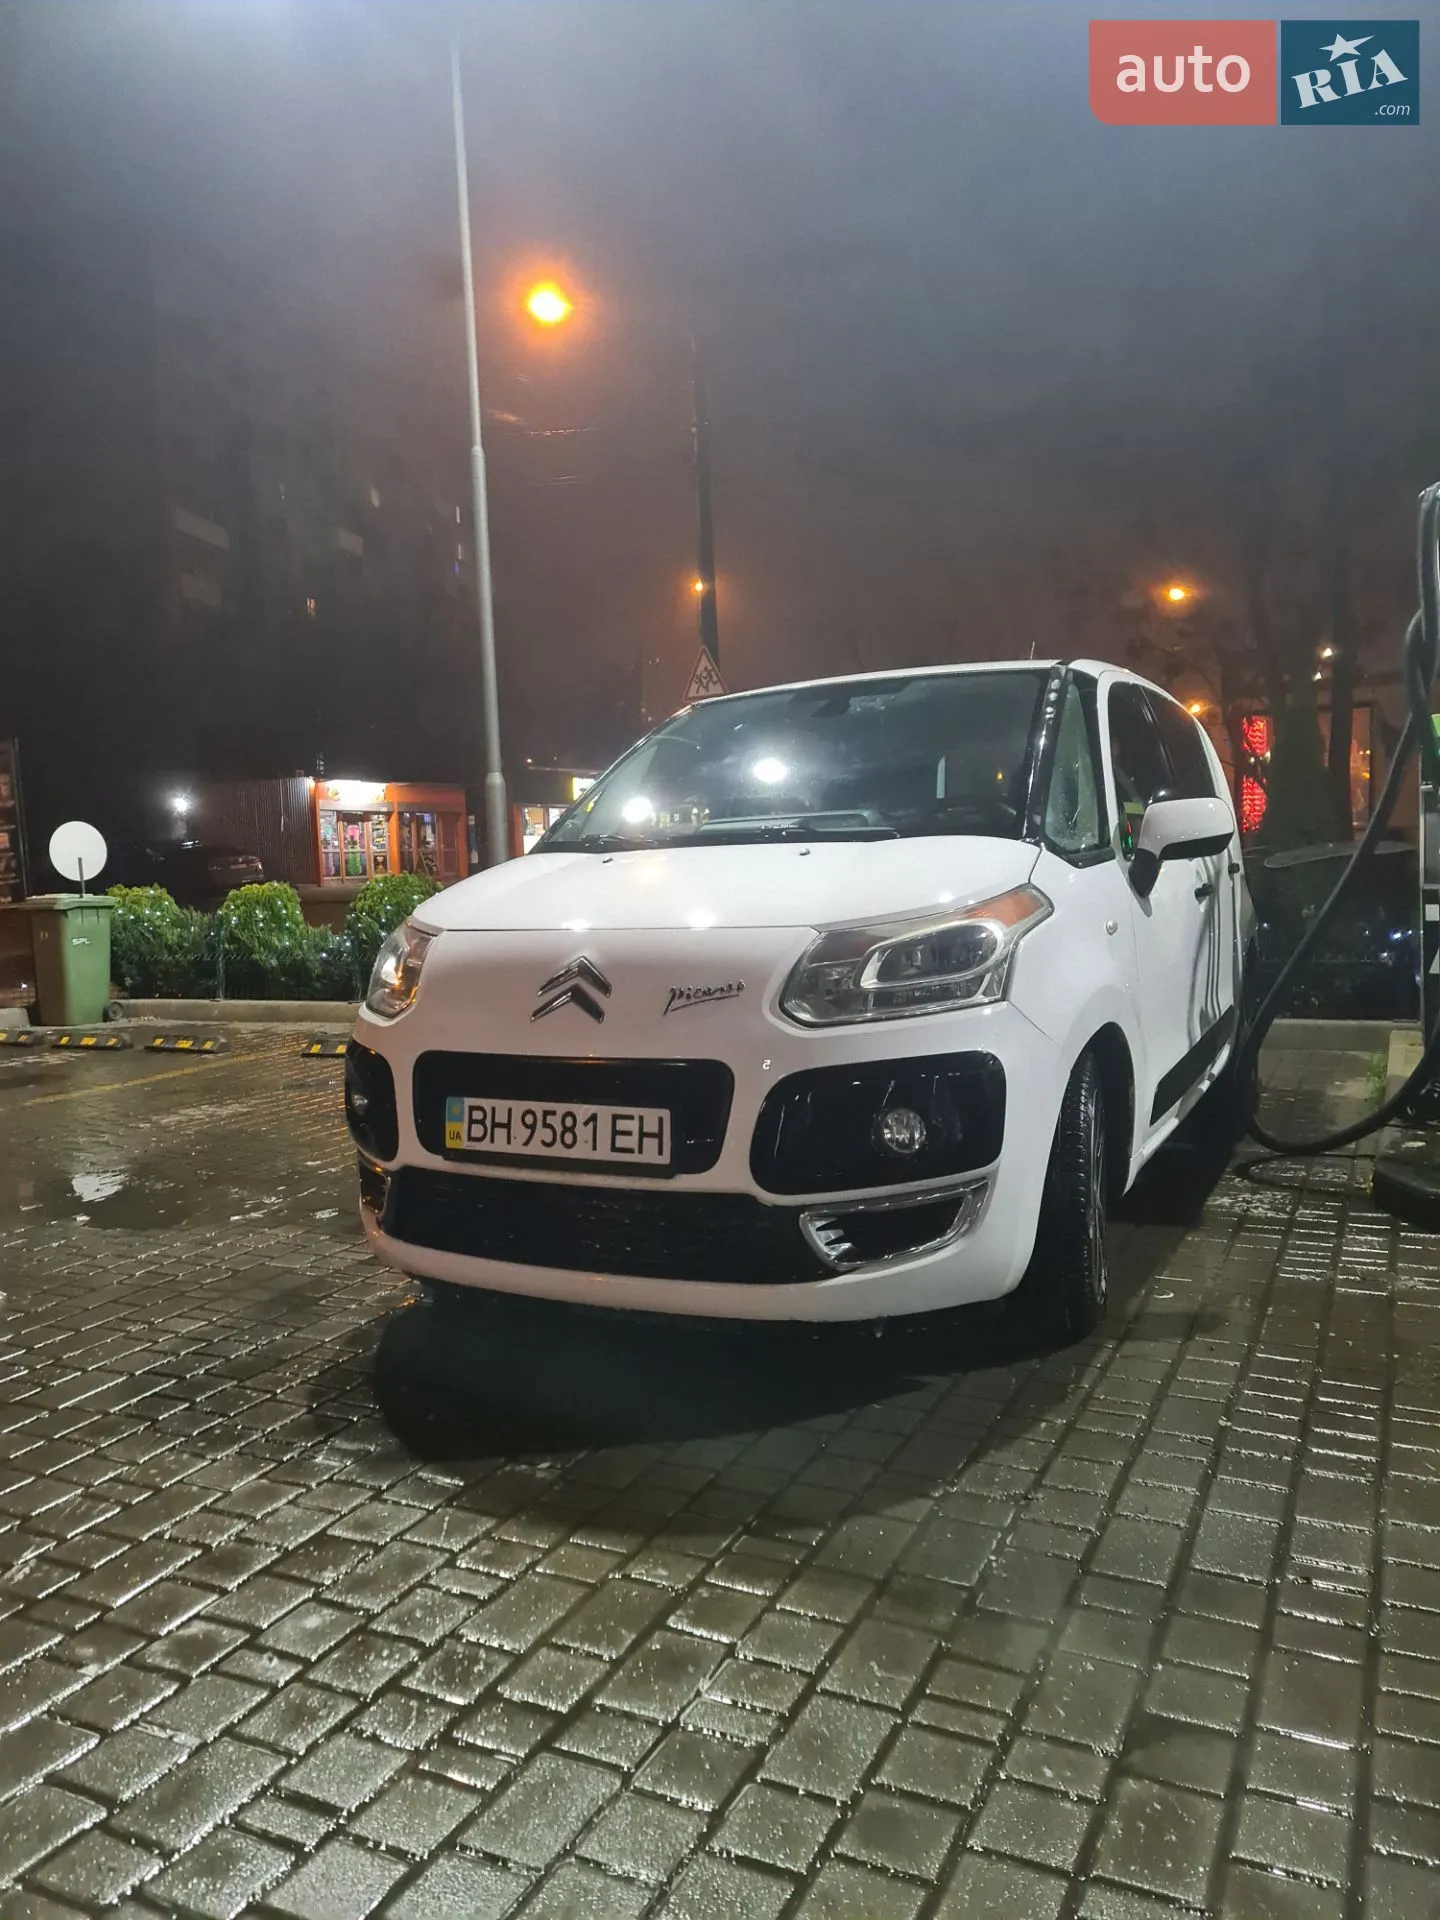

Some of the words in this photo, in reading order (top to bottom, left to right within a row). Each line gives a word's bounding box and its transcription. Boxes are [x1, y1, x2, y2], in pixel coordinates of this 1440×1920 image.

[449, 1129, 462, 1141] UA
[467, 1104, 513, 1145] BH
[520, 1108, 598, 1152] 9581
[610, 1113, 664, 1156] EH
